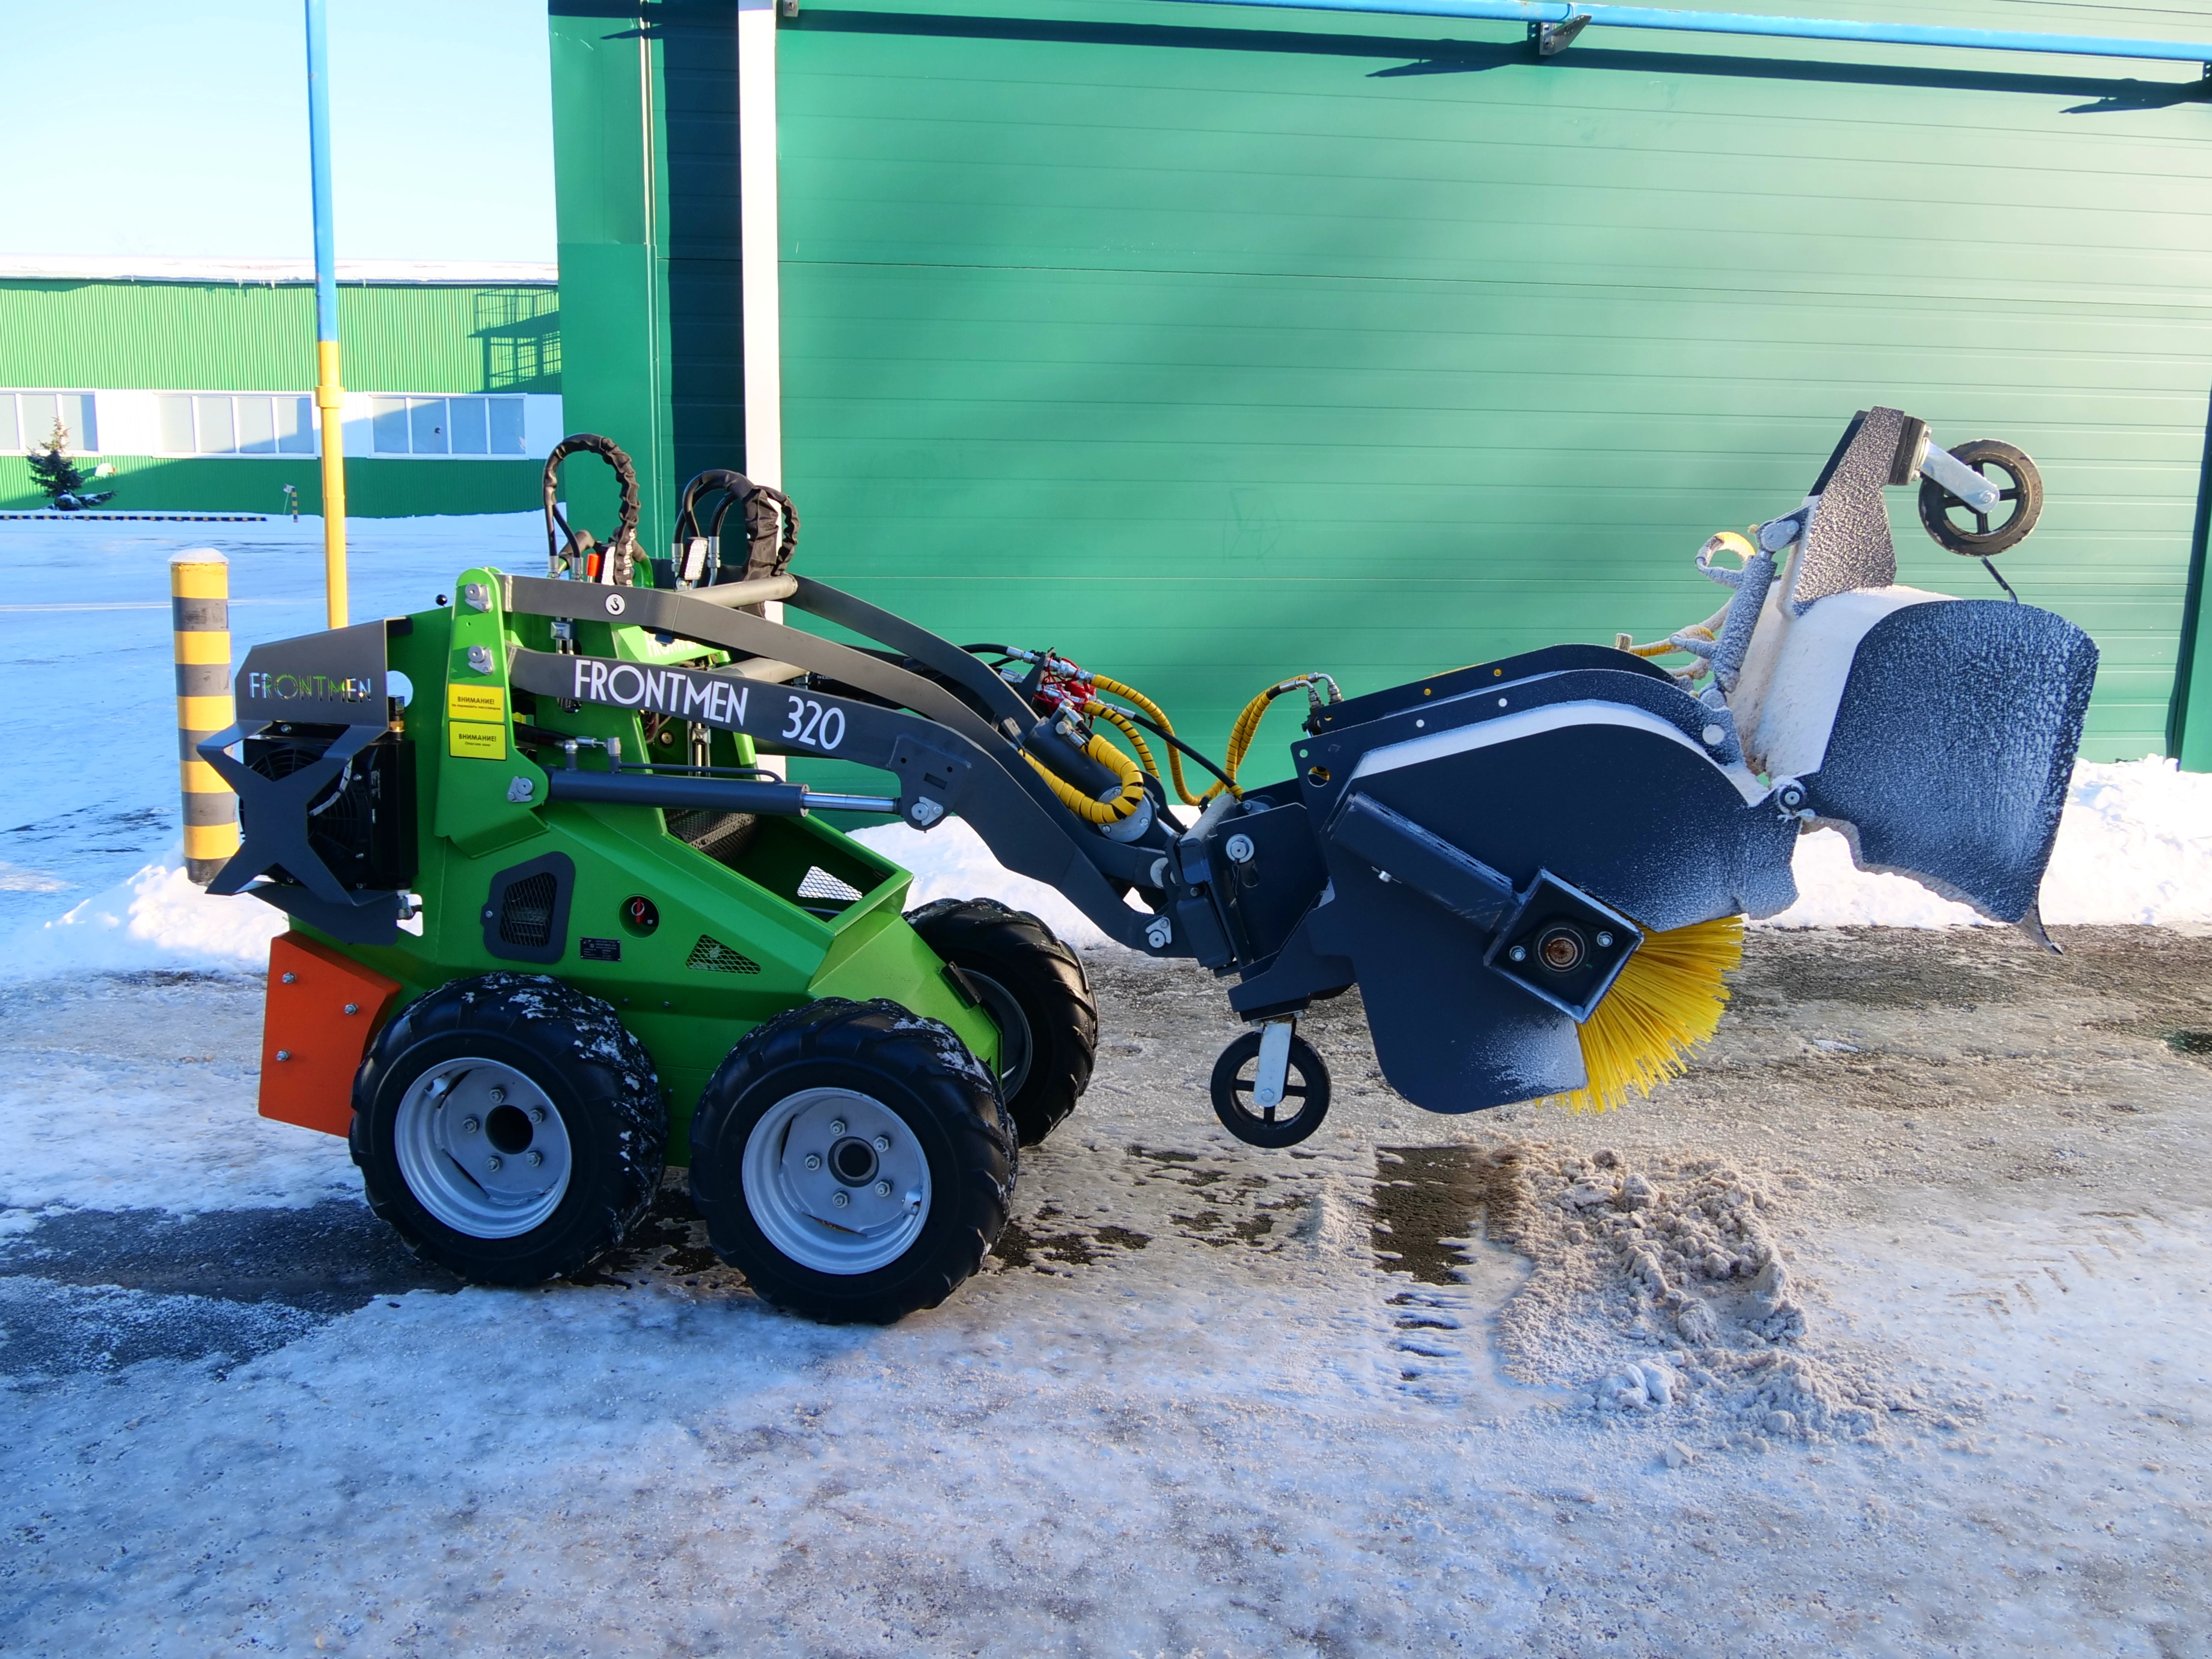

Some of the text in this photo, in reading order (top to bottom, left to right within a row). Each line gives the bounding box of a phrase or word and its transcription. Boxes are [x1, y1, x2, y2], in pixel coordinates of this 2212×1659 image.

[249, 672, 371, 703] FRONTMEN
[457, 696, 495, 705] ВНИМАНИЕ!
[575, 659, 846, 750] FRONTMEN 320
[459, 733, 496, 742] ВНИМАНИЕ!
